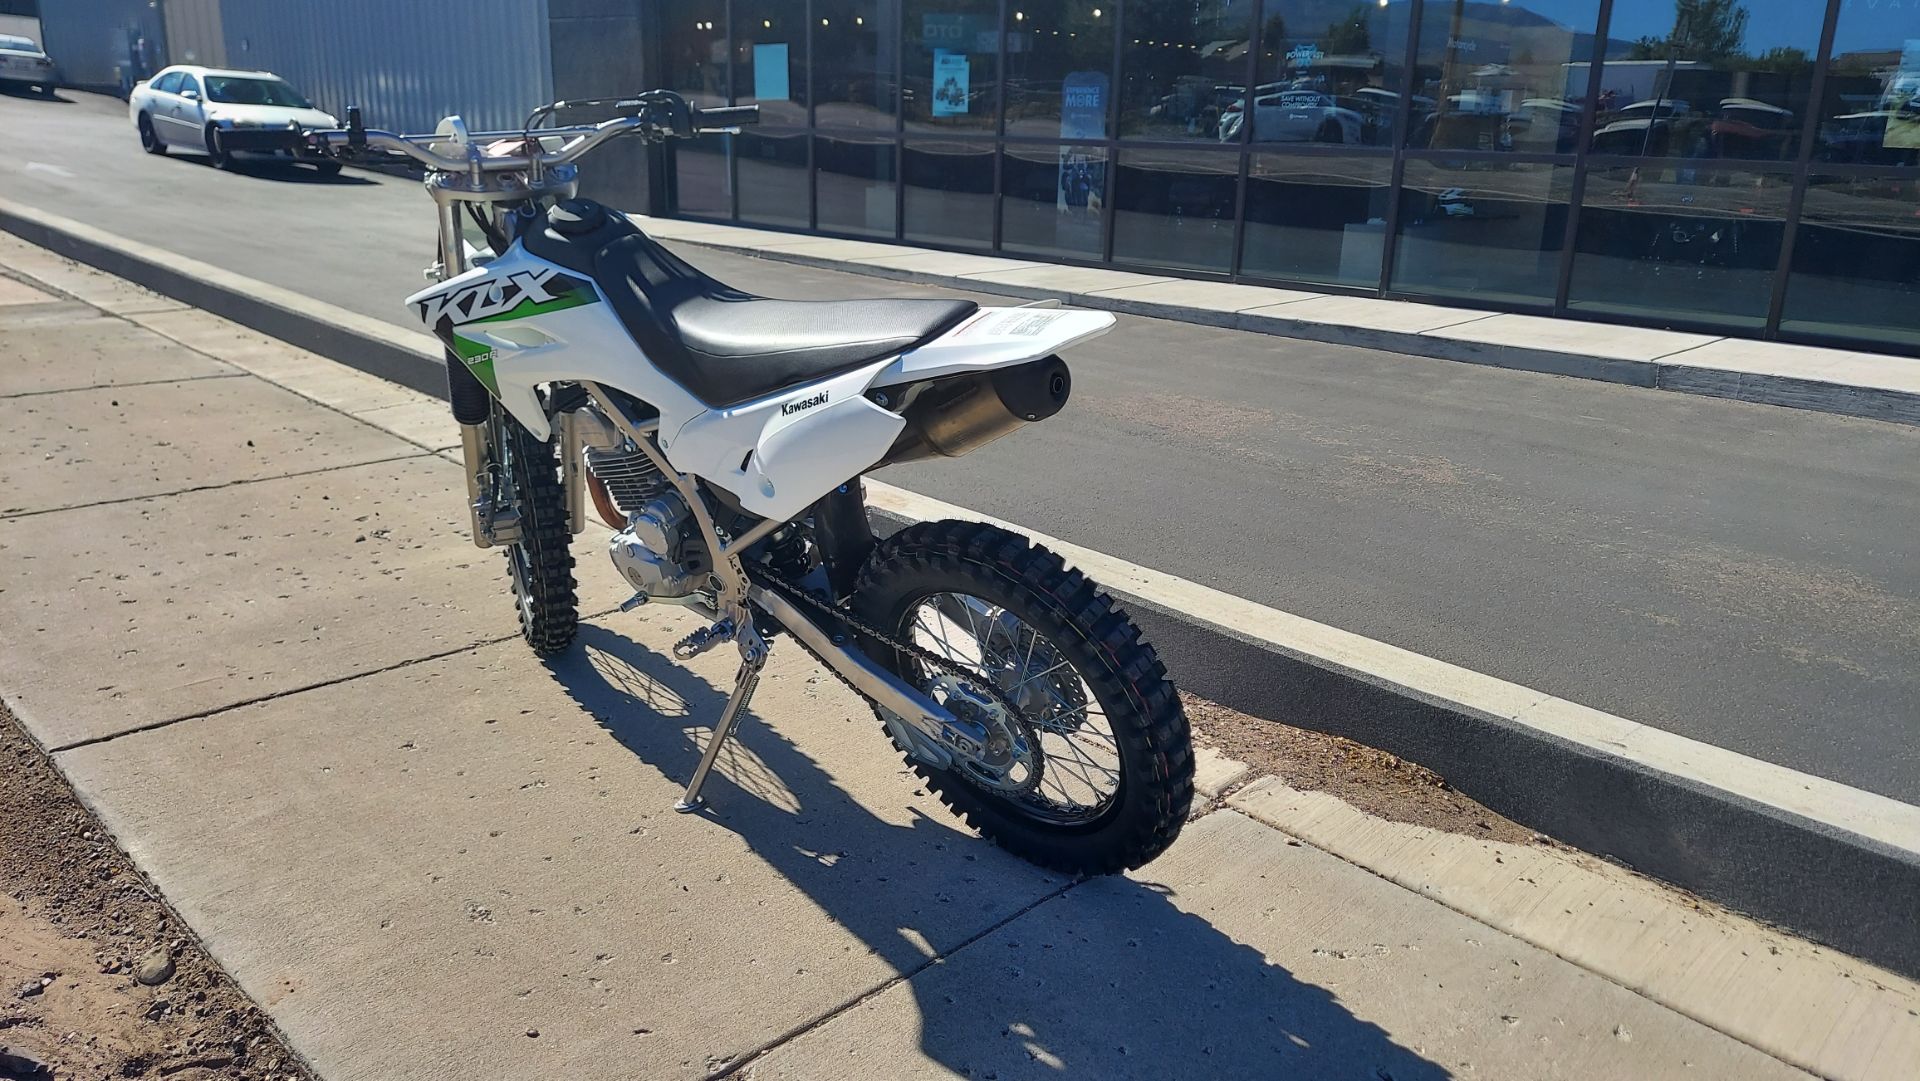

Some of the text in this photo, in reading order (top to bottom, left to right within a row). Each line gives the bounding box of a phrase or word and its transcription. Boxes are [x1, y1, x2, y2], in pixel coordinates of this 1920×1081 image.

[1065, 95, 1100, 107] MORE
[420, 268, 559, 331] KLX
[781, 390, 829, 417] Kawasaki
